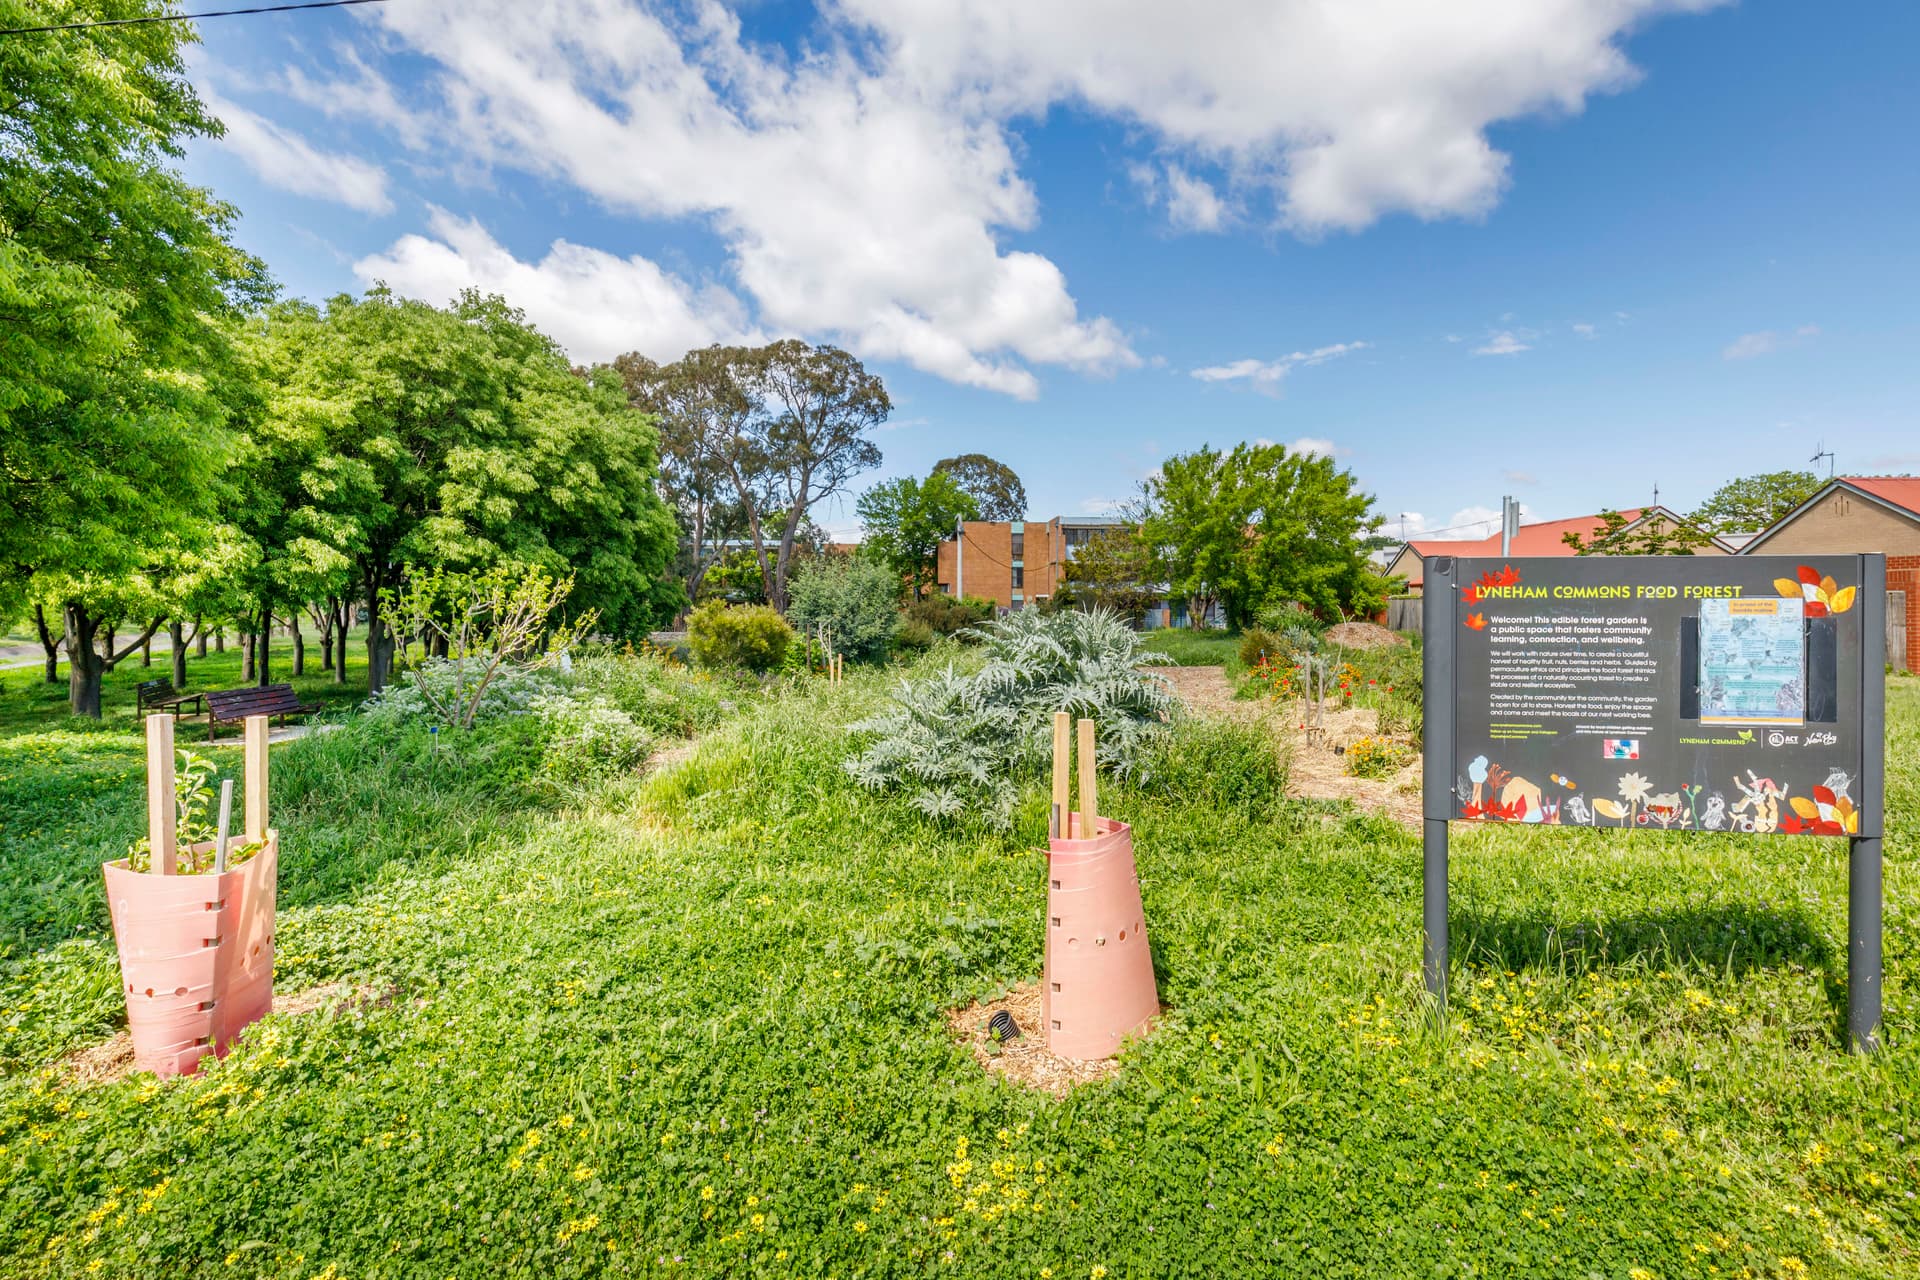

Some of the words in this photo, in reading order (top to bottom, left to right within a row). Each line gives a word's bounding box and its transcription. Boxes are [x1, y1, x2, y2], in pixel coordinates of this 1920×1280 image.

[1476, 586, 1548, 598] LYNEHAM
[1553, 586, 1631, 598] COMMONS
[1637, 586, 1678, 598] FOOD
[1684, 586, 1743, 598] FOREST
[1607, 617, 1638, 625] garden
[1604, 627, 1652, 635] community
[1490, 635, 1527, 644] learning,
[1600, 636, 1645, 645] wellbeing.
